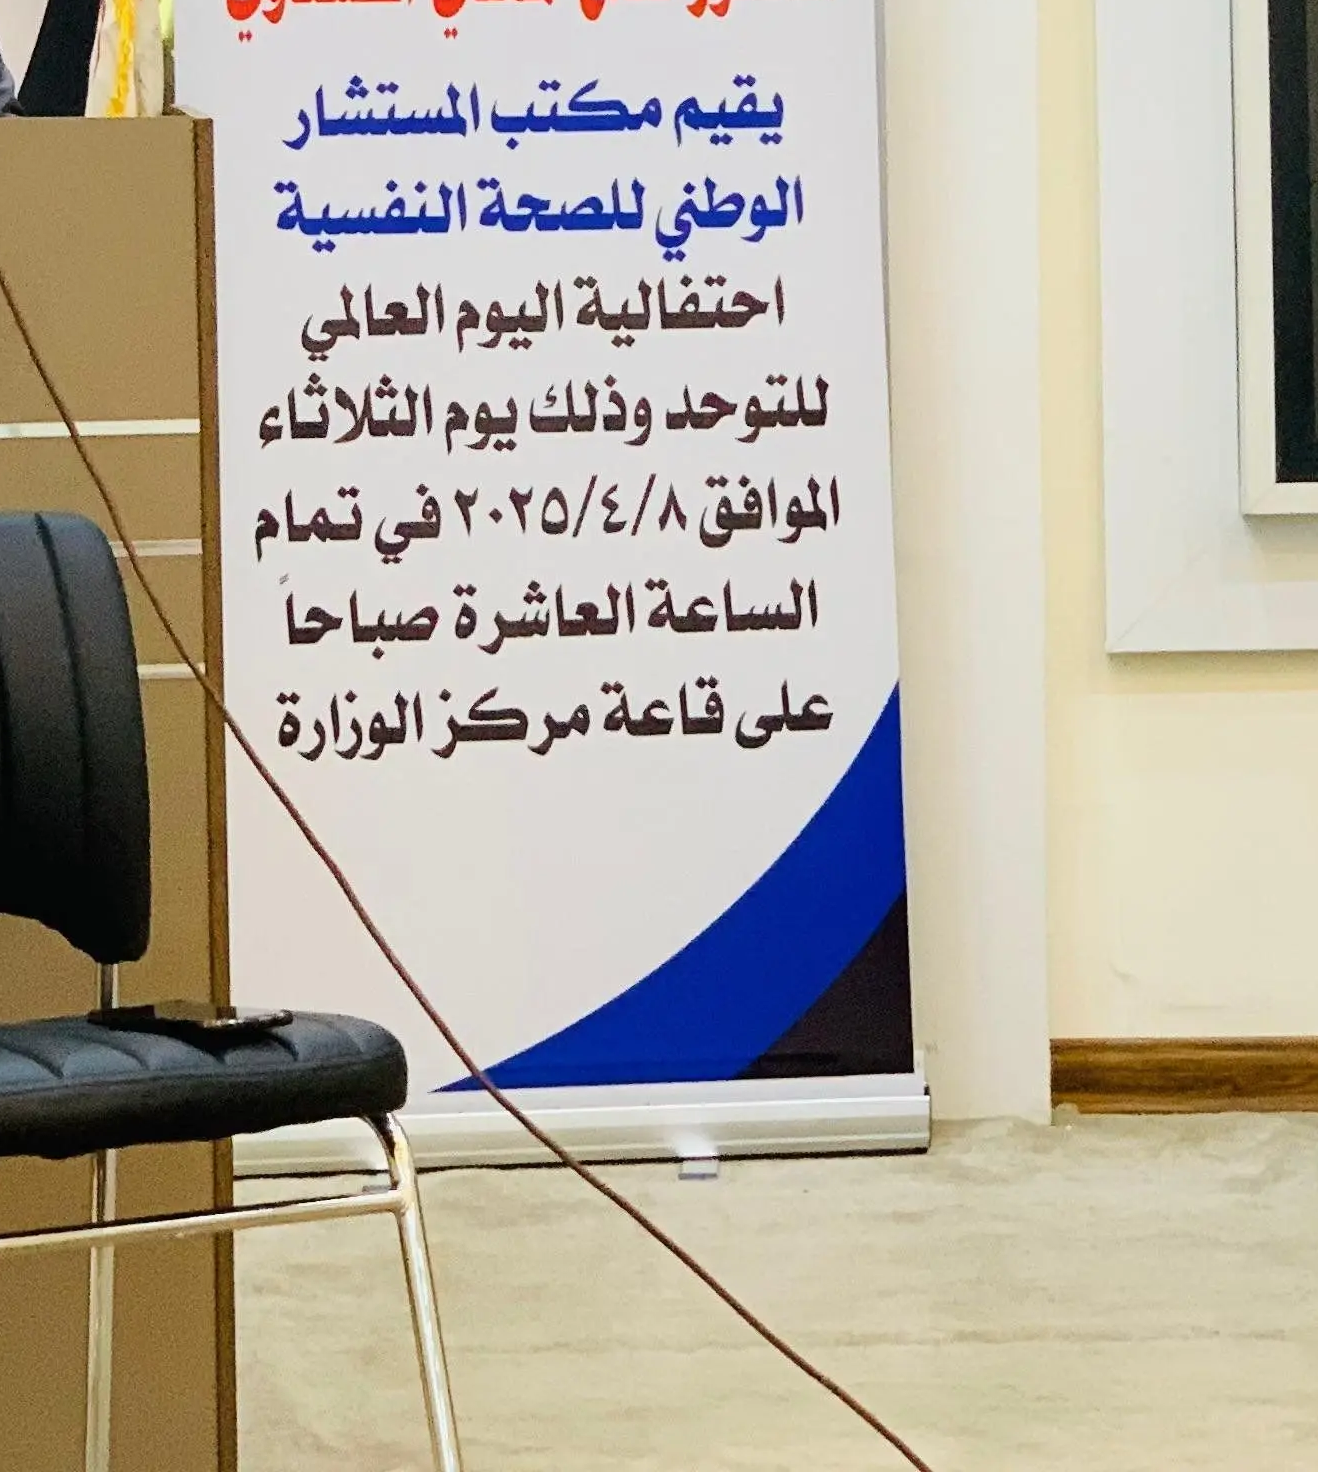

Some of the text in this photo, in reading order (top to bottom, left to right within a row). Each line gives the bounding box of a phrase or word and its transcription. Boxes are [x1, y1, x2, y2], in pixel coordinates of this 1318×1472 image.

[282, 74, 783, 150] يقيم مكتب المستشار
[274, 176, 803, 262] الوطني للصحة النفسية
[301, 274, 785, 362] احتفالية اليوم العالمي
[259, 373, 829, 455] للتوحد وذلك يوم الثلاثاء
[255, 486, 362, 562] تمام
[374, 484, 441, 564] في
[699, 475, 839, 548] الموافق
[453, 580, 635, 655] العاشرة
[645, 578, 818, 633] الساعة
[277, 675, 833, 762] على قاعة مركز الوزارة
